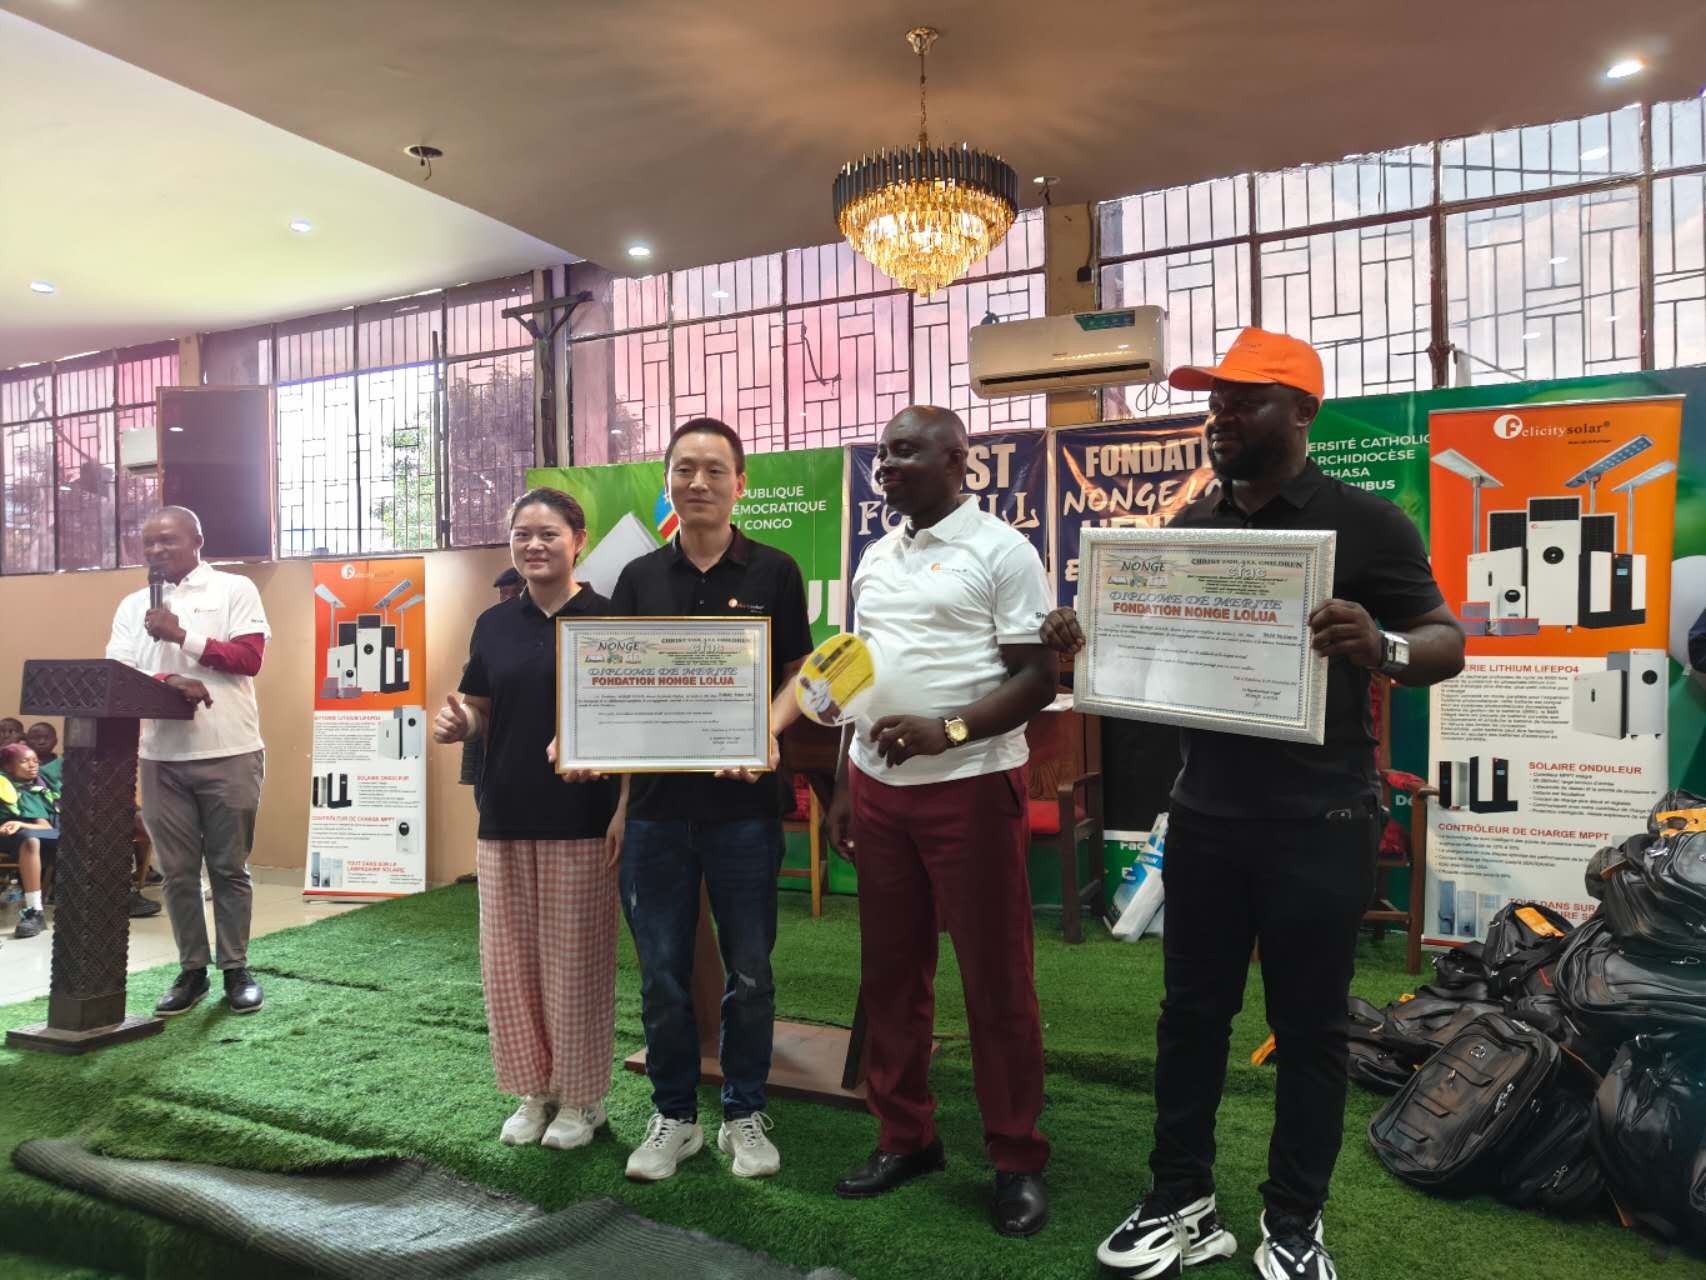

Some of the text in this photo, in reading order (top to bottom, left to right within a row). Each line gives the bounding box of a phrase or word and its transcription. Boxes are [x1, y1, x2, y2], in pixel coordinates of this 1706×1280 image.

[1307, 433, 1430, 452] ERSITÉ CATHOLI
[1322, 467, 1371, 479] SHASA
[742, 486, 804, 499] PUBLIQUE
[1063, 477, 1182, 516] NONGE
[731, 500, 827, 515] ÉMOCRATIQUE
[744, 518, 792, 530] CONGO
[1121, 560, 1166, 573] NONGE
[1113, 602, 1278, 623] FONDATION NONGE LOLUA
[597, 641, 640, 653] NONGE
[1489, 664, 1531, 673] LITHIUM
[1535, 665, 1579, 673] LIFEPO4
[700, 676, 735, 686] LOLUA
[1529, 761, 1642, 774] SOLAIRE ONDULEUR
[1438, 823, 1609, 841] CONTRÔLEUR DE CHARGE MPPT
[1574, 903, 1595, 912] SUR
